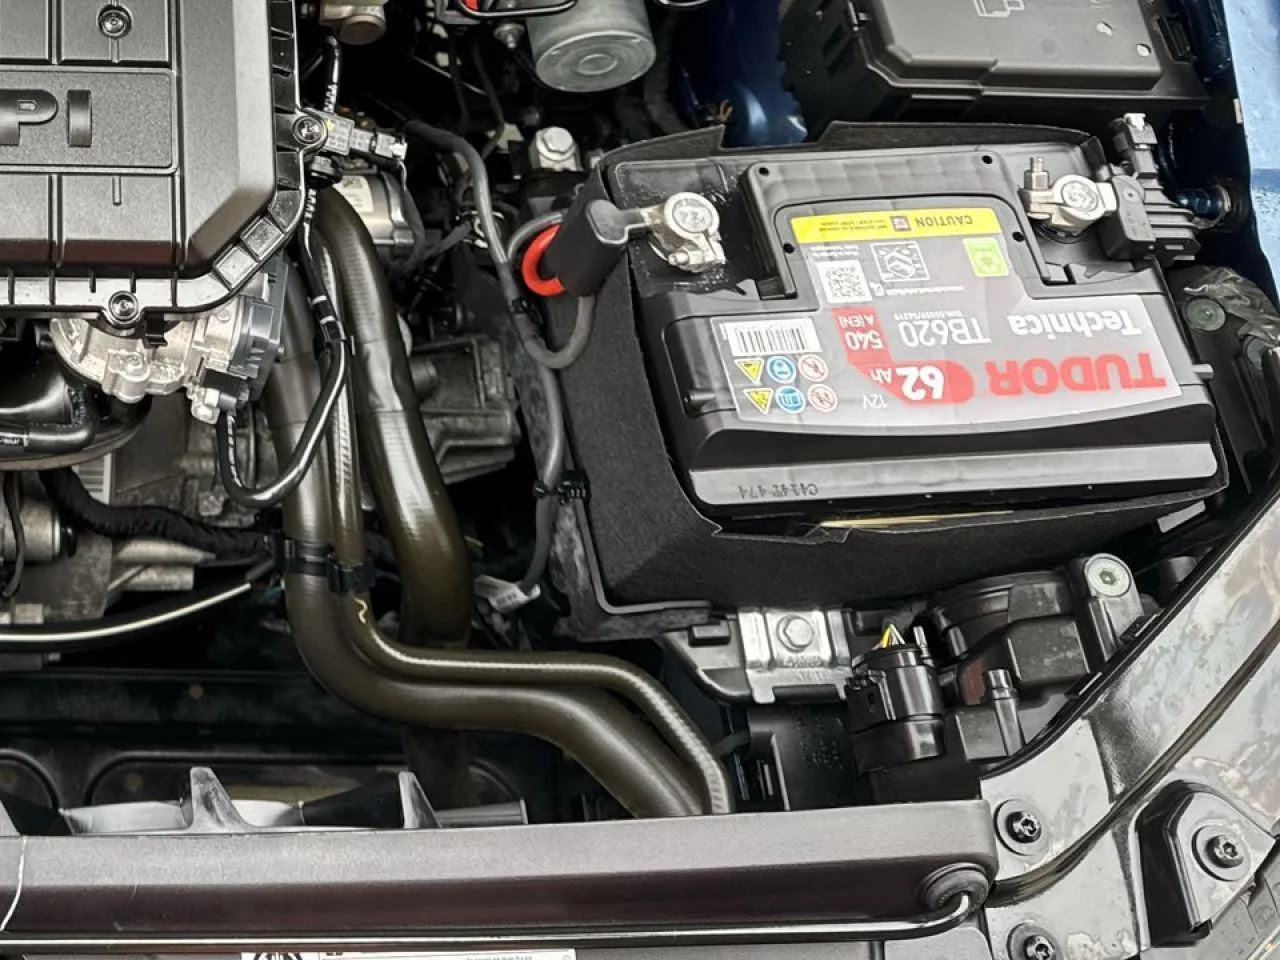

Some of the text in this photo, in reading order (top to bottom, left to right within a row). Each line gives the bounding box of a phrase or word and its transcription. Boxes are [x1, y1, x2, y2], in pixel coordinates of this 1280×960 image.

[915, 214, 973, 228] CAUTION
[897, 316, 992, 347] TB620
[1007, 309, 1142, 340] Technica
[844, 330, 884, 351] 540
[870, 367, 892, 385] Ah
[895, 365, 945, 401] 62
[984, 351, 1167, 396] TUDOR
[862, 394, 888, 410] 12V
